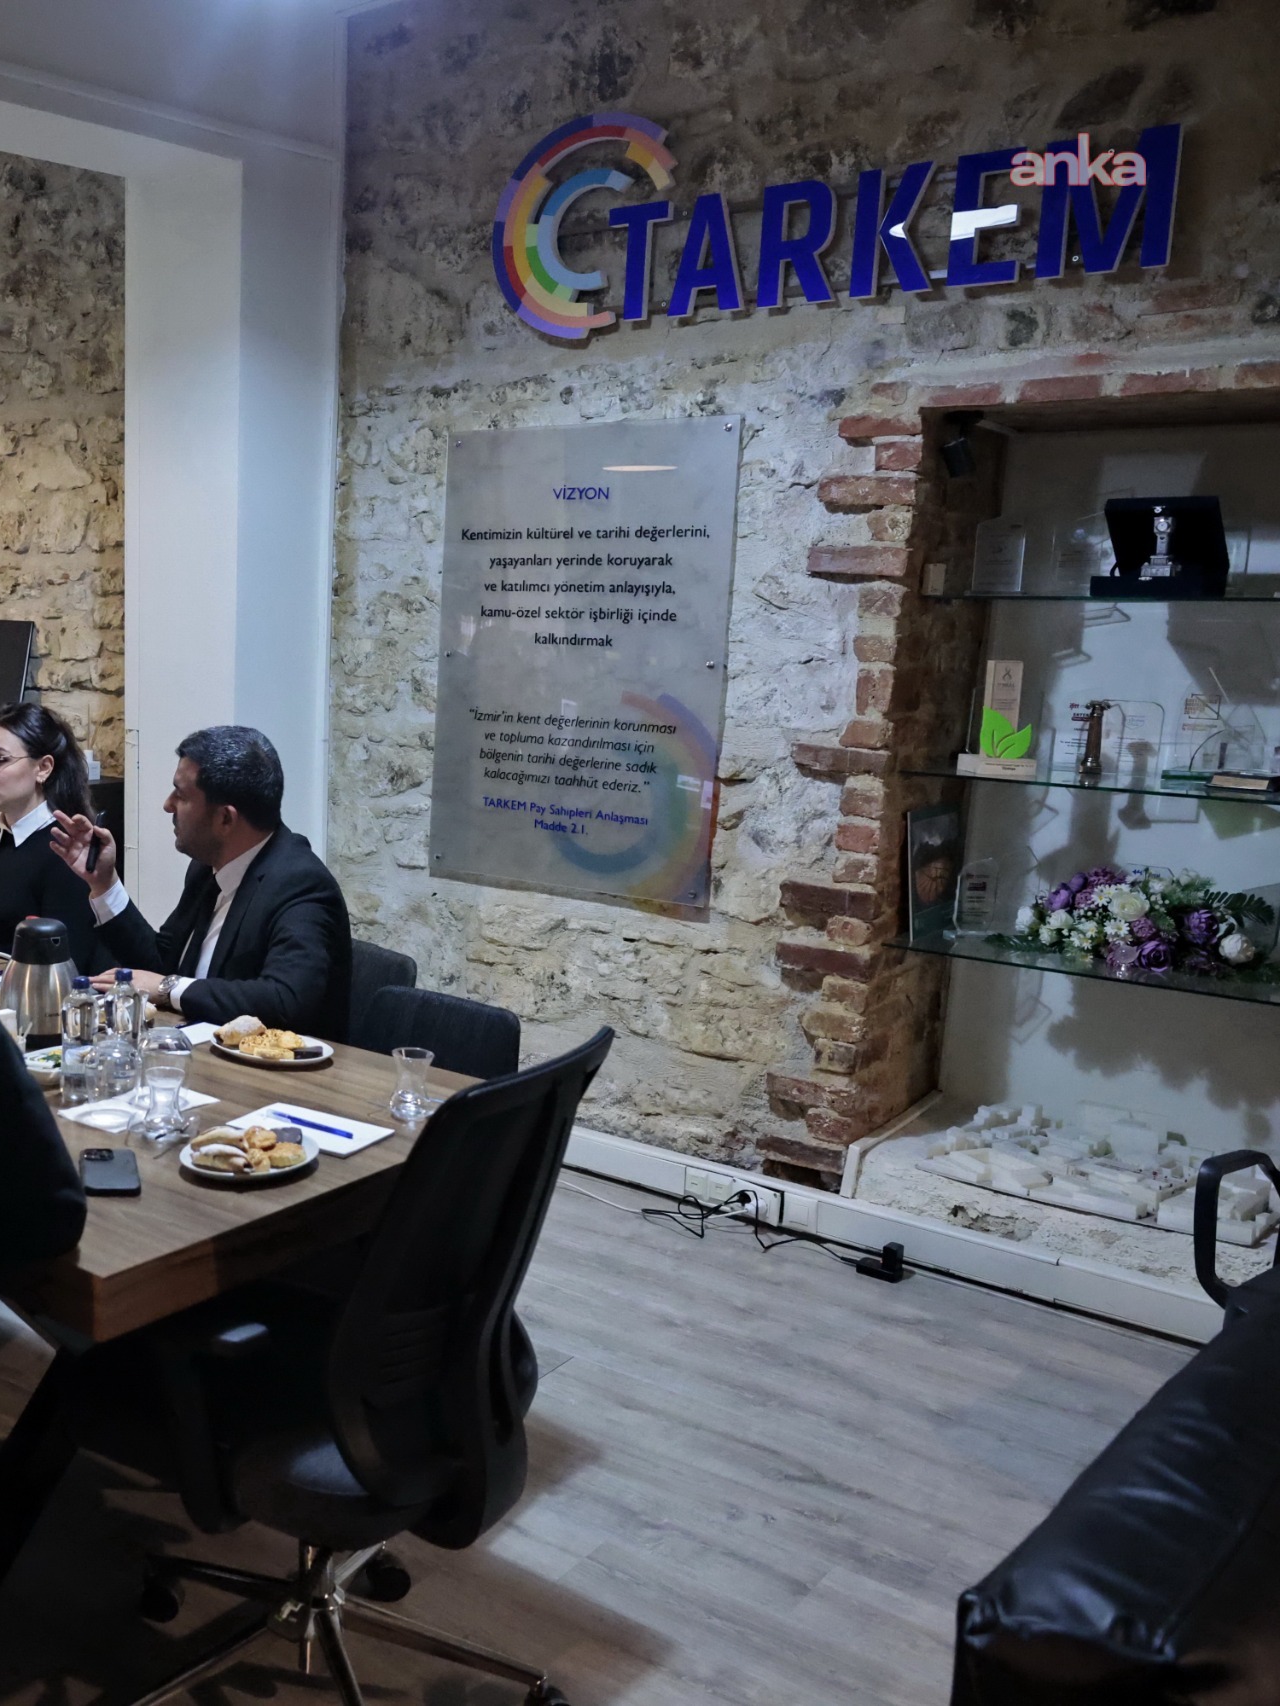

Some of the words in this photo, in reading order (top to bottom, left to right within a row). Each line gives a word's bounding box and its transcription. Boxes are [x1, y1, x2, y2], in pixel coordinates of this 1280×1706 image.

[609, 123, 1184, 321] TARKEM
[553, 485, 610, 500] VİZYON
[461, 528, 523, 541] Kentimizin
[526, 527, 574, 540] kültürel
[578, 530, 592, 539] ve
[596, 526, 630, 539] tarihi
[634, 524, 710, 542] değerlerini,
[489, 553, 552, 569] yaşayanları
[556, 554, 603, 569] yerinde
[607, 553, 673, 569] koruyarak
[484, 582, 497, 592] ve
[501, 580, 550, 592] katılımcı
[554, 581, 605, 595] yönetim
[609, 581, 676, 597] anlayışıyla,
[480, 606, 541, 618] kamu-özel
[545, 607, 585, 619] sektör
[589, 607, 634, 624] işbirliği
[638, 609, 677, 624] içinde
[534, 632, 613, 647] kalkındırmak
[516, 712, 541, 725] kent
[544, 714, 610, 730] değerlerinin
[613, 718, 677, 734] korunması
[484, 732, 496, 740] ve
[500, 731, 544, 744] topluma
[547, 733, 631, 751] kazandırılması
[634, 740, 655, 755] için
[479, 748, 523, 763] bölgenin
[527, 753, 556, 765] tarihi
[558, 755, 622, 771] değerlerine
[625, 761, 657, 774] sadık
[483, 767, 551, 785] kalacağımızı
[554, 775, 598, 789] taahhüt
[482, 796, 527, 812] TARKEM
[530, 802, 546, 816] Pay
[549, 804, 593, 820] Sahipleri
[595, 810, 649, 826] Anlaşması
[534, 819, 568, 833] Madde
